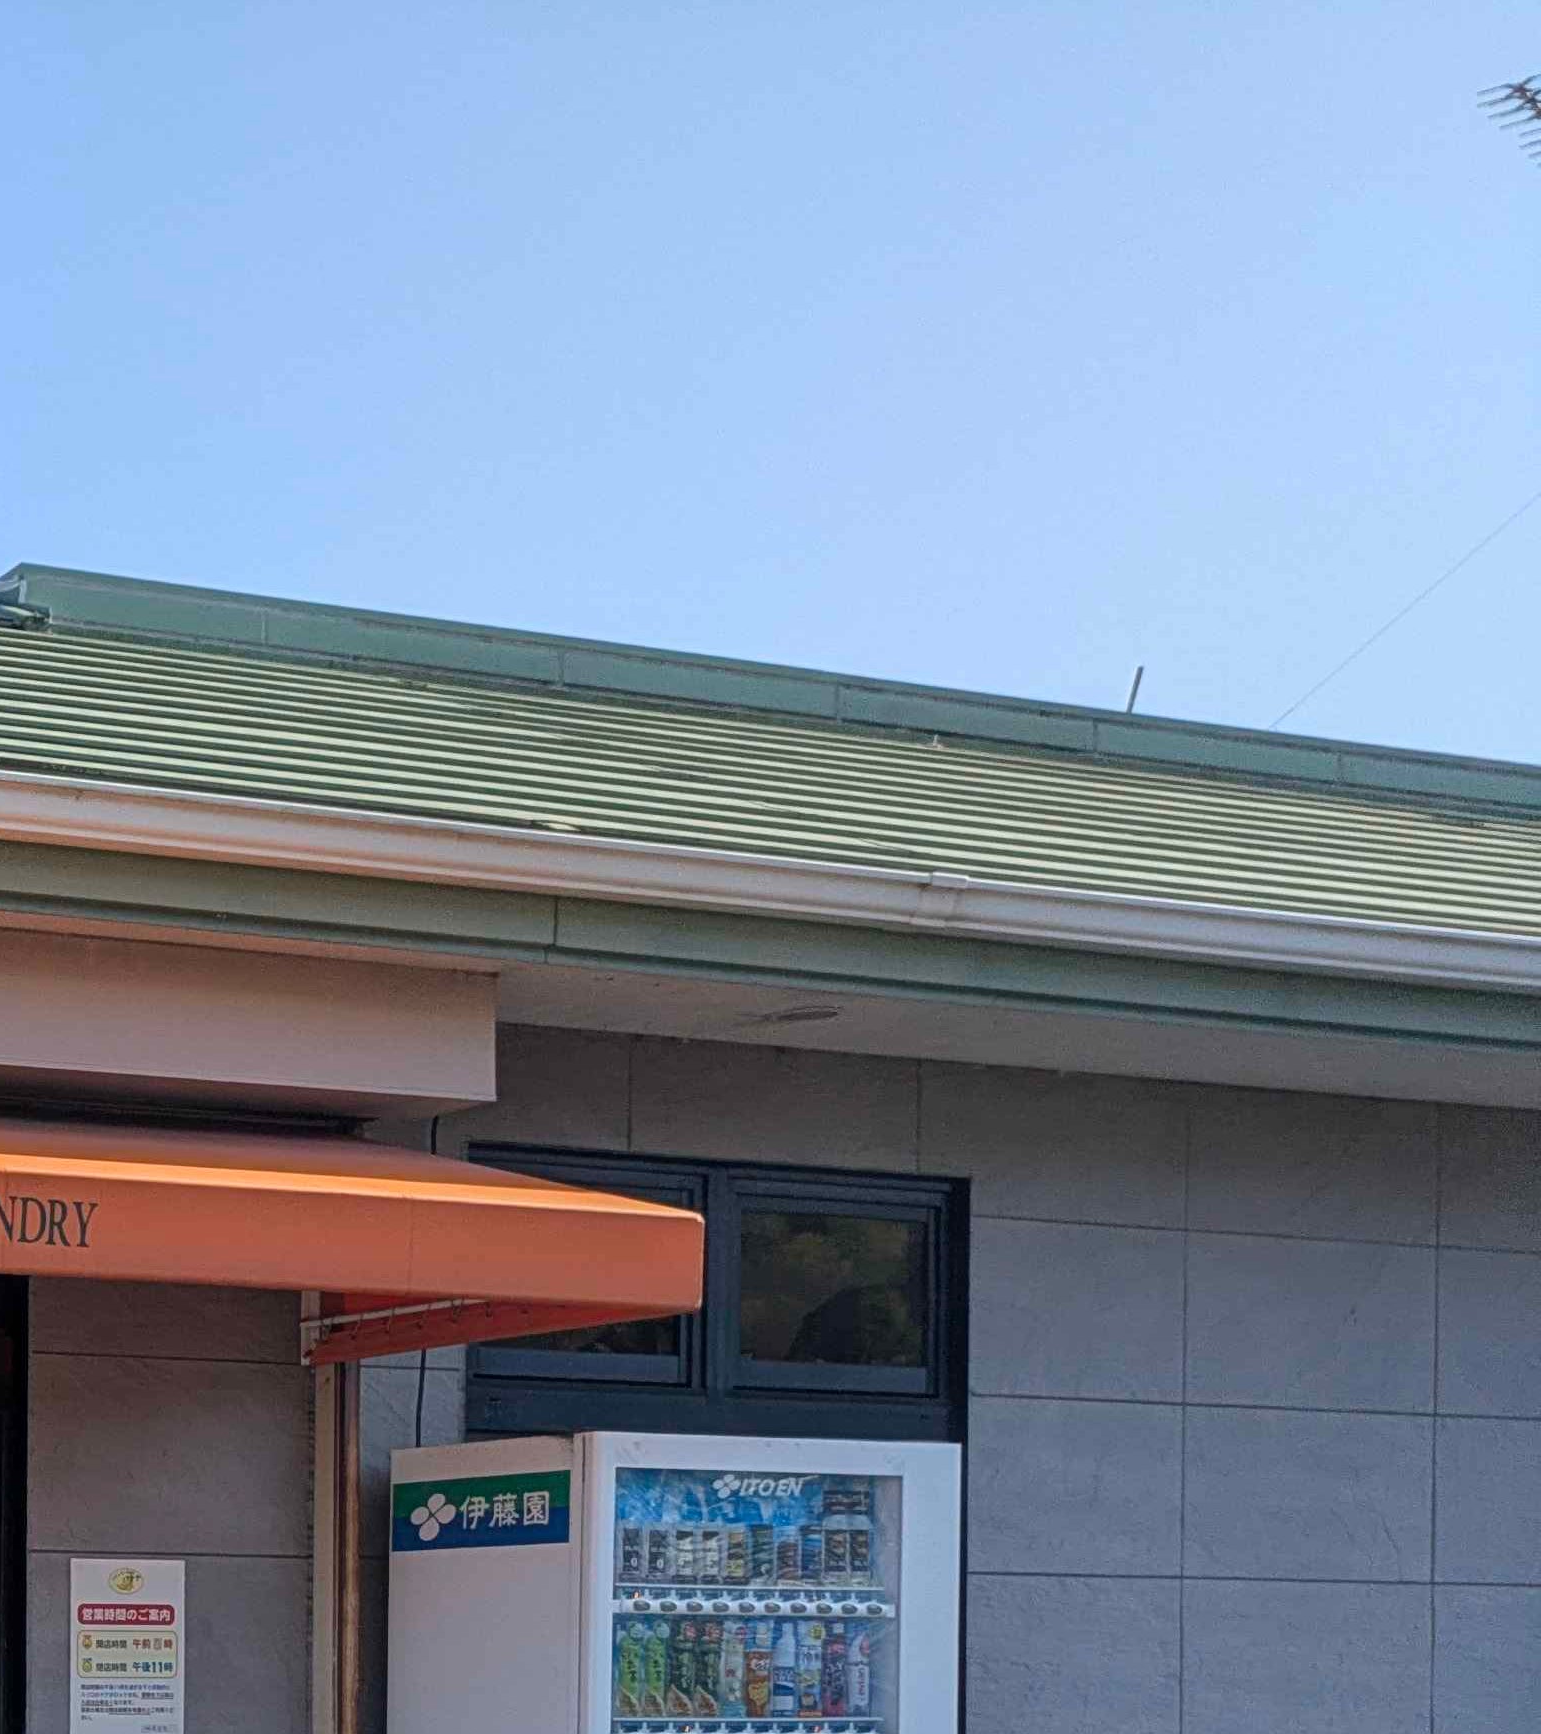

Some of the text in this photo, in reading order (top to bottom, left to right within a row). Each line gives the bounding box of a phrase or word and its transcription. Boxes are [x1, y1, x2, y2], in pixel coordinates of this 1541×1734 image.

[459, 1490, 550, 1531] 伊藤園
[81, 1607, 171, 1622] 営業時間のご案内
